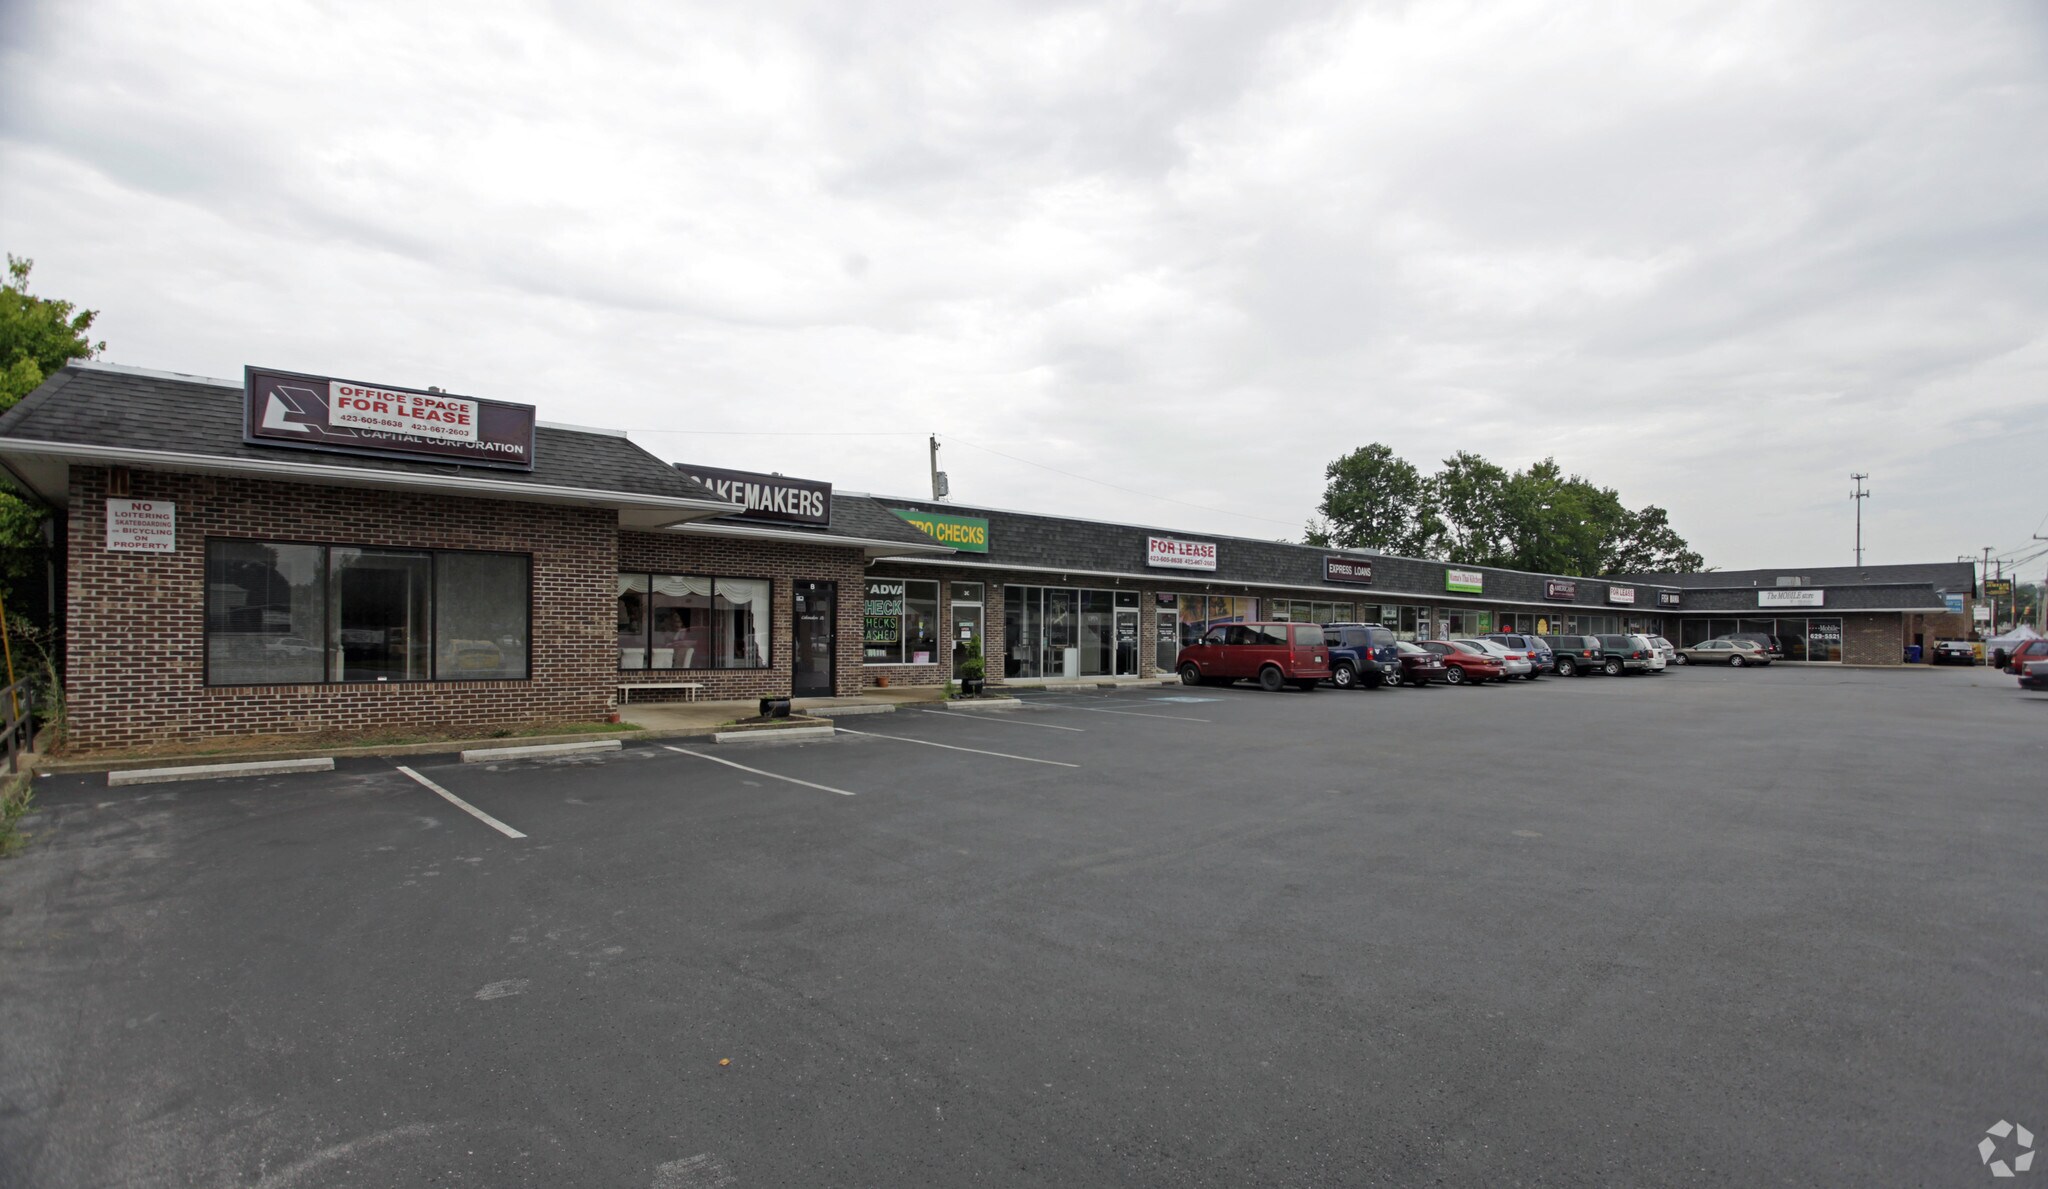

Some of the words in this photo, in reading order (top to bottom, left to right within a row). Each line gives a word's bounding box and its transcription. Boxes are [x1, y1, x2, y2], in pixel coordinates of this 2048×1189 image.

[339, 386, 407, 404] OFFICE
[412, 397, 469, 413] SPACE
[338, 396, 389, 414] FOR
[397, 405, 471, 426] LEASE
[340, 414, 403, 428] 423-605-8638
[410, 423, 469, 437] 423-667-2603
[131, 502, 152, 512] NO
[114, 511, 170, 520] LOITERING
[115, 519, 172, 528] SKATEBOARDING
[122, 527, 173, 536] BICYCLING
[936, 522, 984, 545] CHECKS
[113, 541, 169, 549] PROPERTY
[1150, 539, 1175, 554] FOR
[1179, 543, 1215, 558] LEASE
[1329, 563, 1353, 575] EXPRESS
[1354, 566, 1372, 577] LOANS
[1767, 591, 1777, 600] The
[864, 617, 896, 629] HECKS
[864, 629, 896, 641] ASHED
